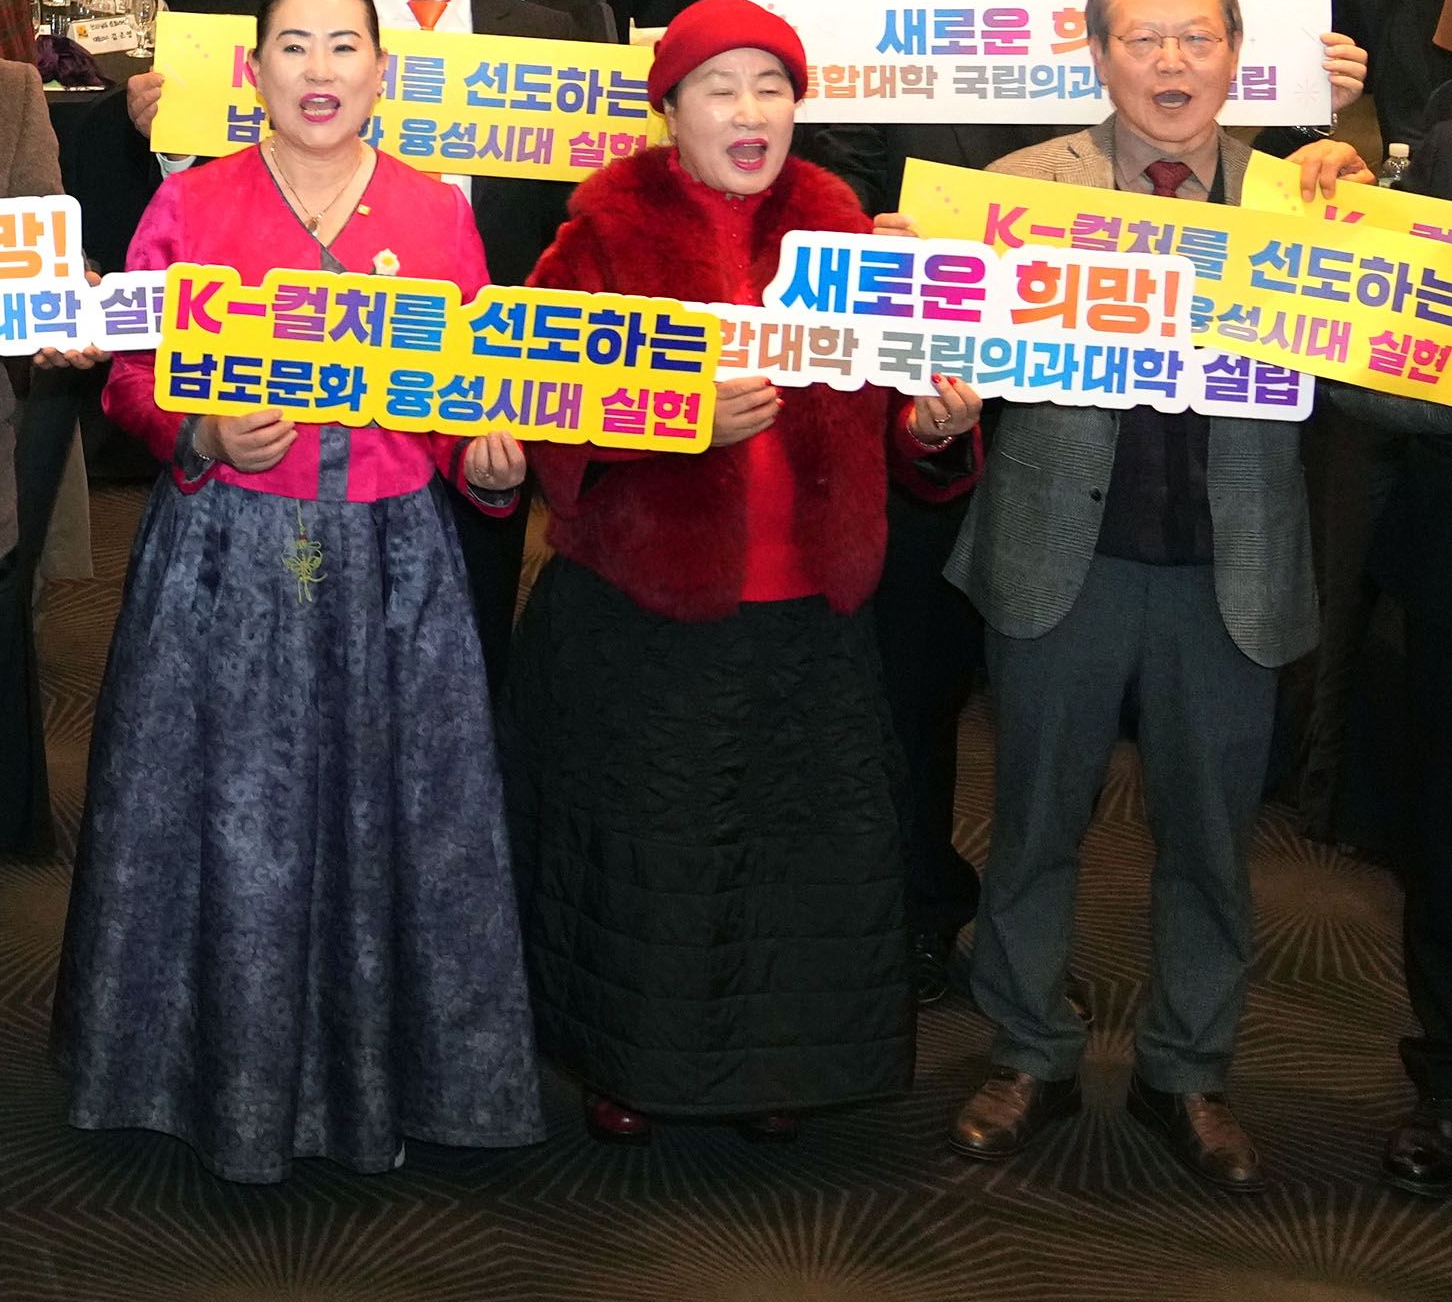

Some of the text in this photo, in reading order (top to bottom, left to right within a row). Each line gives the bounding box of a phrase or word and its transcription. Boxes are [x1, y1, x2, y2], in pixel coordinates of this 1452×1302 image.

[876, 7, 1032, 56] 새로운
[463, 61, 649, 119] 선도하는
[952, 64, 1103, 101] 국립의과
[398, 118, 556, 165] 융성시대
[780, 245, 1177, 338] 새로운 희망!
[1248, 238, 1452, 328] 선도하는
[174, 278, 709, 374] K-컬처를 선도하는
[1367, 329, 1452, 385] 실현
[168, 351, 701, 440] 남도문화 융성시대 실현
[718, 320, 1302, 407] 합대학 국립의과대학 설립
